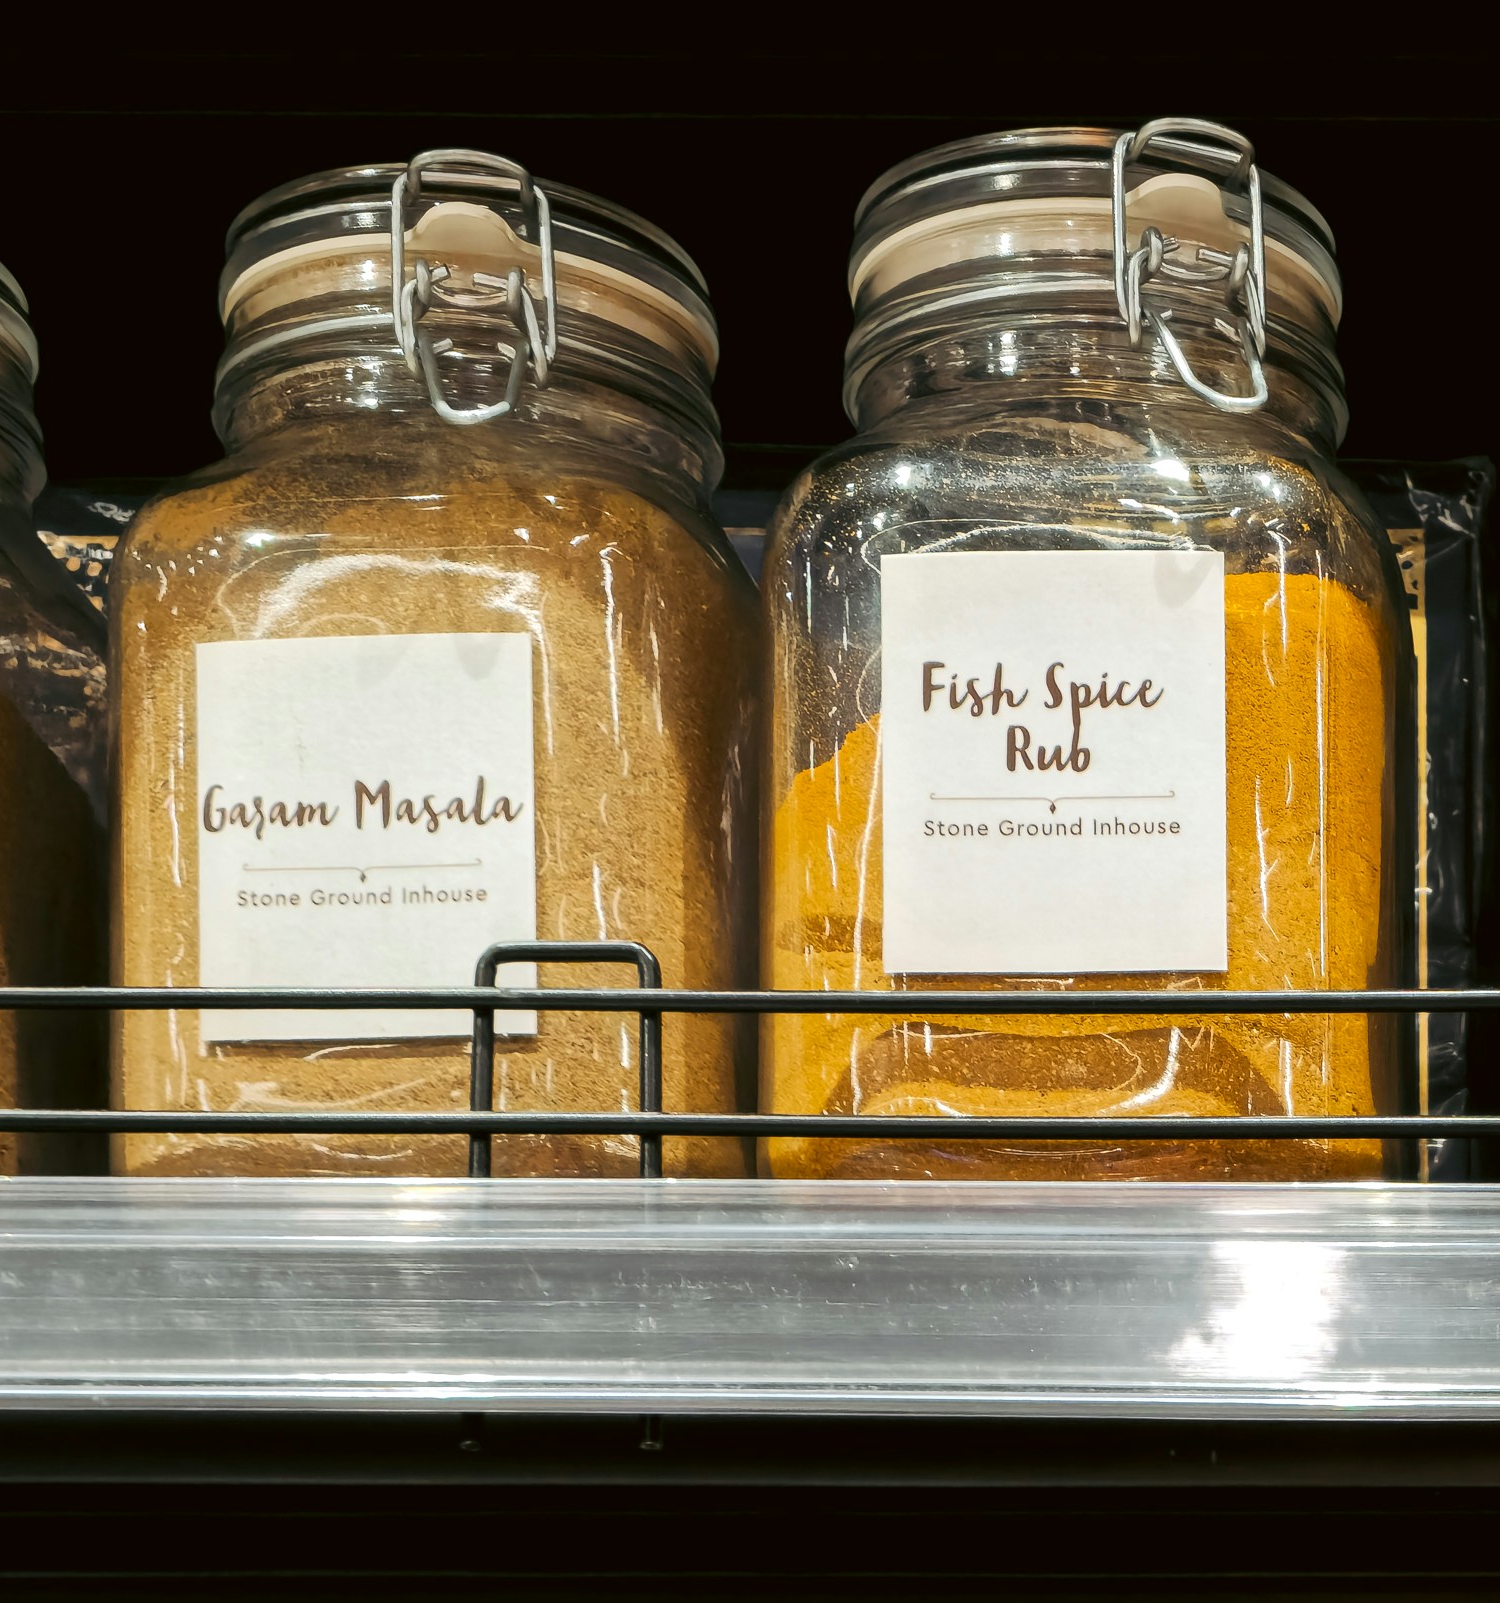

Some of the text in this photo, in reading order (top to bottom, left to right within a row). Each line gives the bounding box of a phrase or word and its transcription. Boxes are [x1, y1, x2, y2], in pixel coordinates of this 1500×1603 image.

[923, 661, 1164, 729] Fish Spice
[1006, 721, 1091, 773] Rub
[204, 775, 522, 840] Garam Masala
[924, 816, 1181, 838] Stone Ground Inhouse
[237, 884, 488, 907] Stone Ground Inhouse
